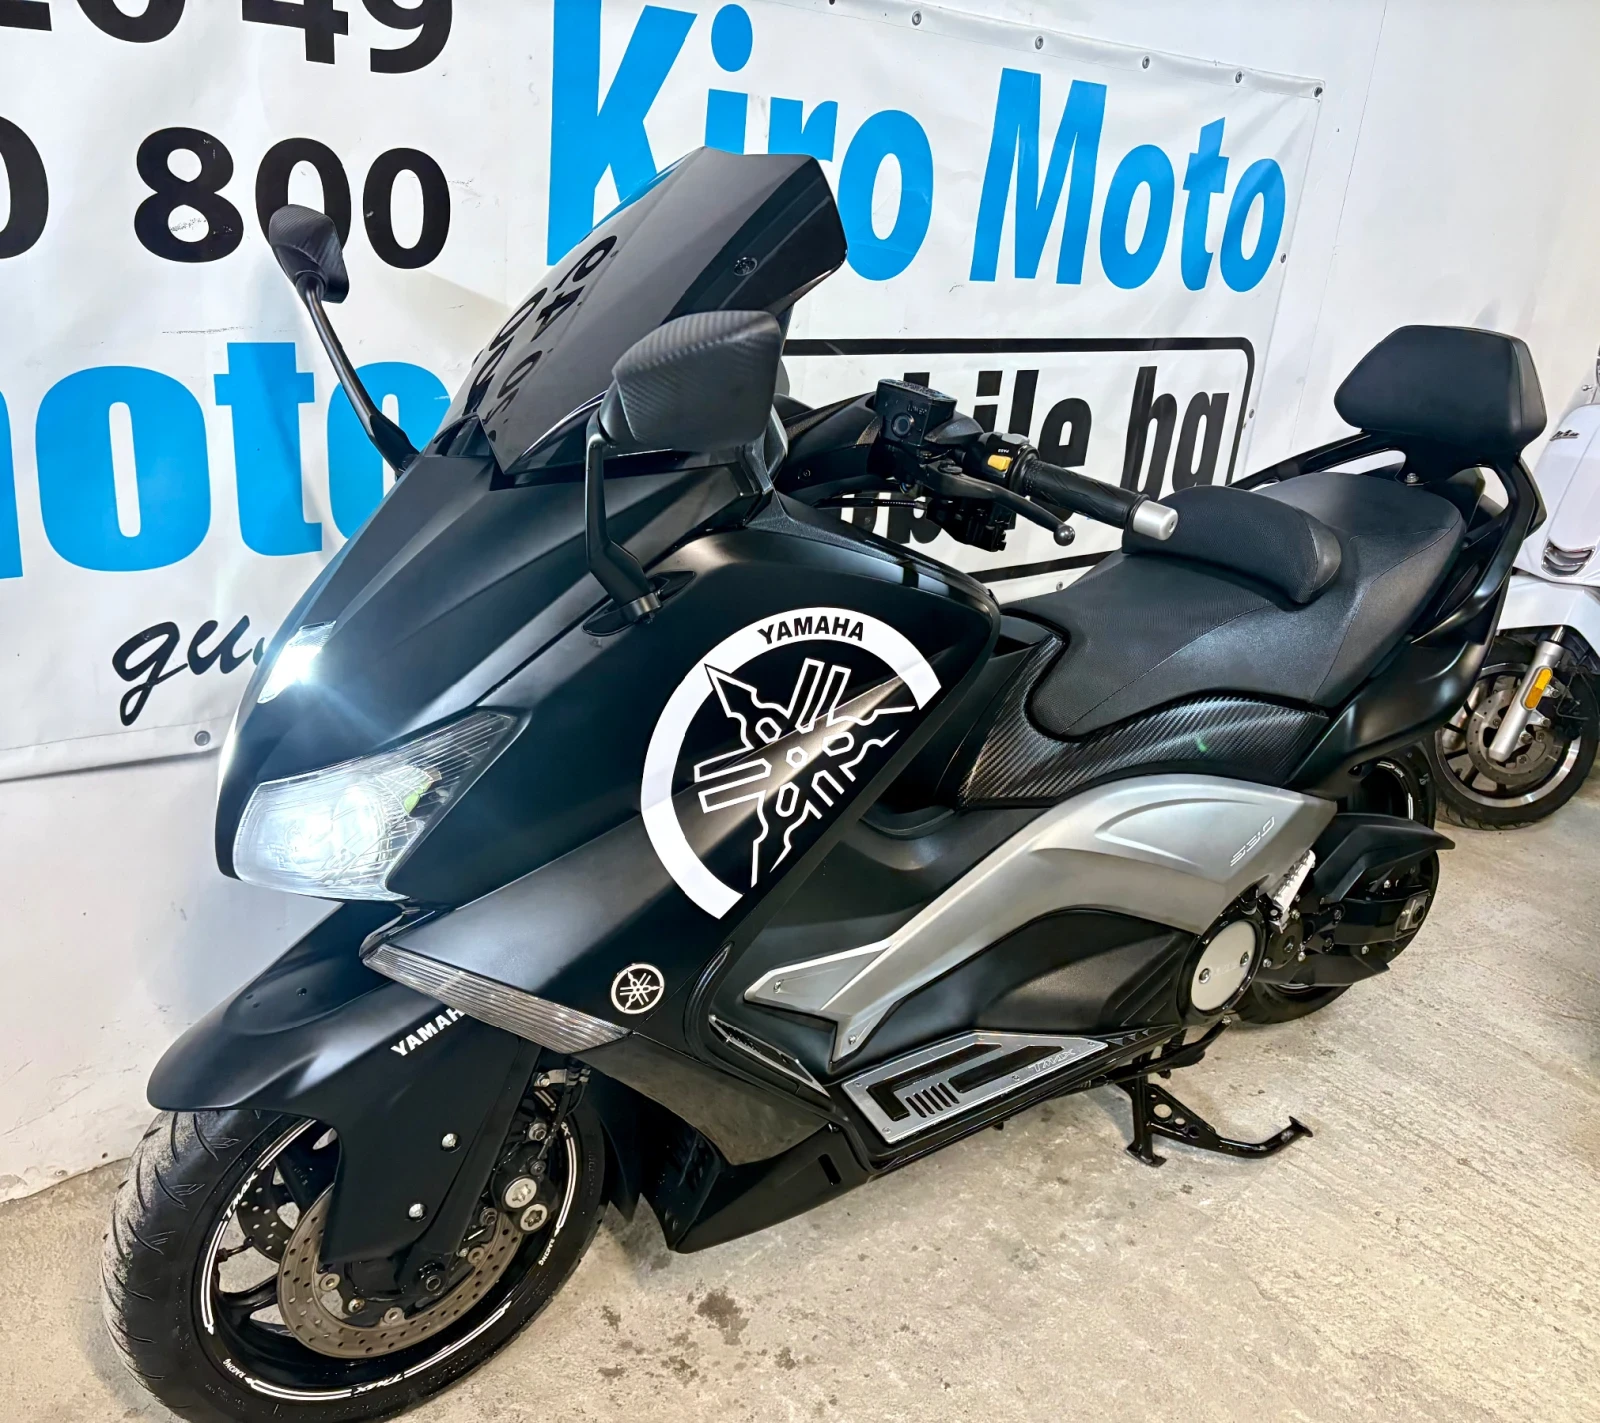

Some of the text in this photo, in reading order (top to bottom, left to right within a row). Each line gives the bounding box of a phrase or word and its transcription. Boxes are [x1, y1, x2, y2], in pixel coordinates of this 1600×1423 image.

[134, 127, 451, 269] 800
[969, 67, 1286, 293] Moto
[0, 342, 451, 579] oto
[757, 616, 864, 645] YAMAHA
[1230, 816, 1275, 867] 530
[390, 1008, 466, 1057] YAMAH
